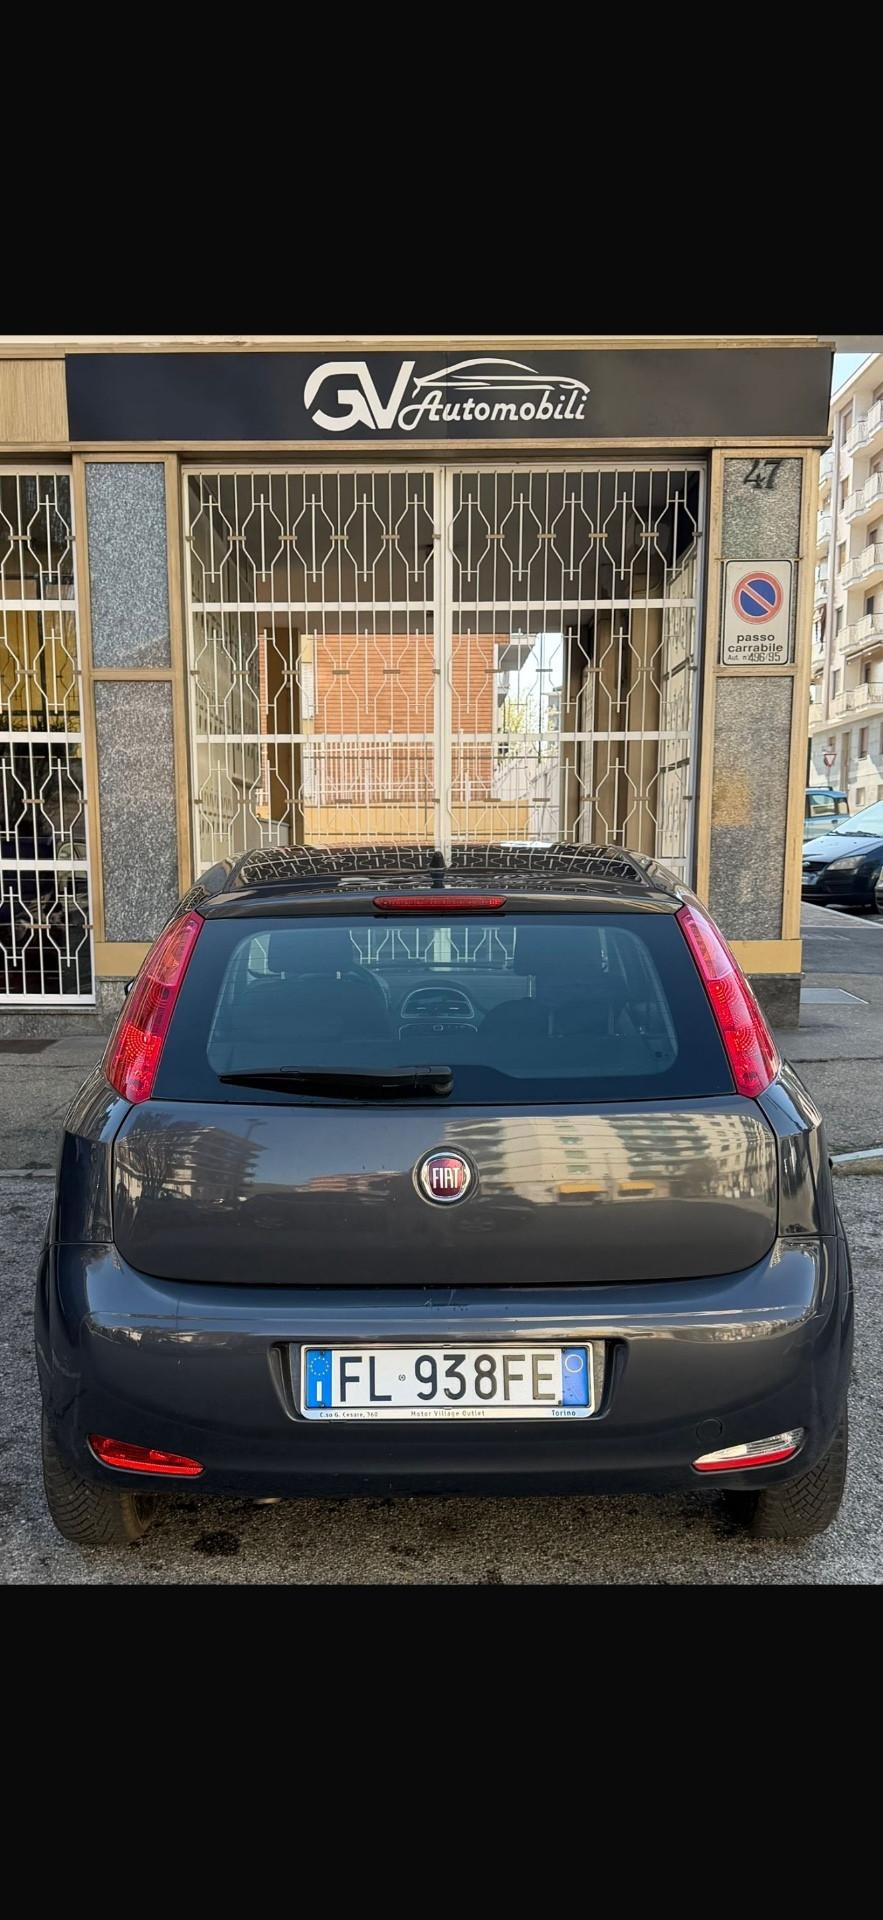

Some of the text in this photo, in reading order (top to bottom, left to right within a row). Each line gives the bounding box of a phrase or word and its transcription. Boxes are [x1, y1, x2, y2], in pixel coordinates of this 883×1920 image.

[303, 360, 588, 432] GV Automobili
[743, 459, 783, 489] 47
[728, 643, 783, 652] carrabile
[737, 634, 775, 643] passo
[432, 1167, 460, 1189] FIAT
[340, 1356, 393, 1402] FL
[414, 1354, 556, 1401] 938FE
[434, 1410, 459, 1418] Village
